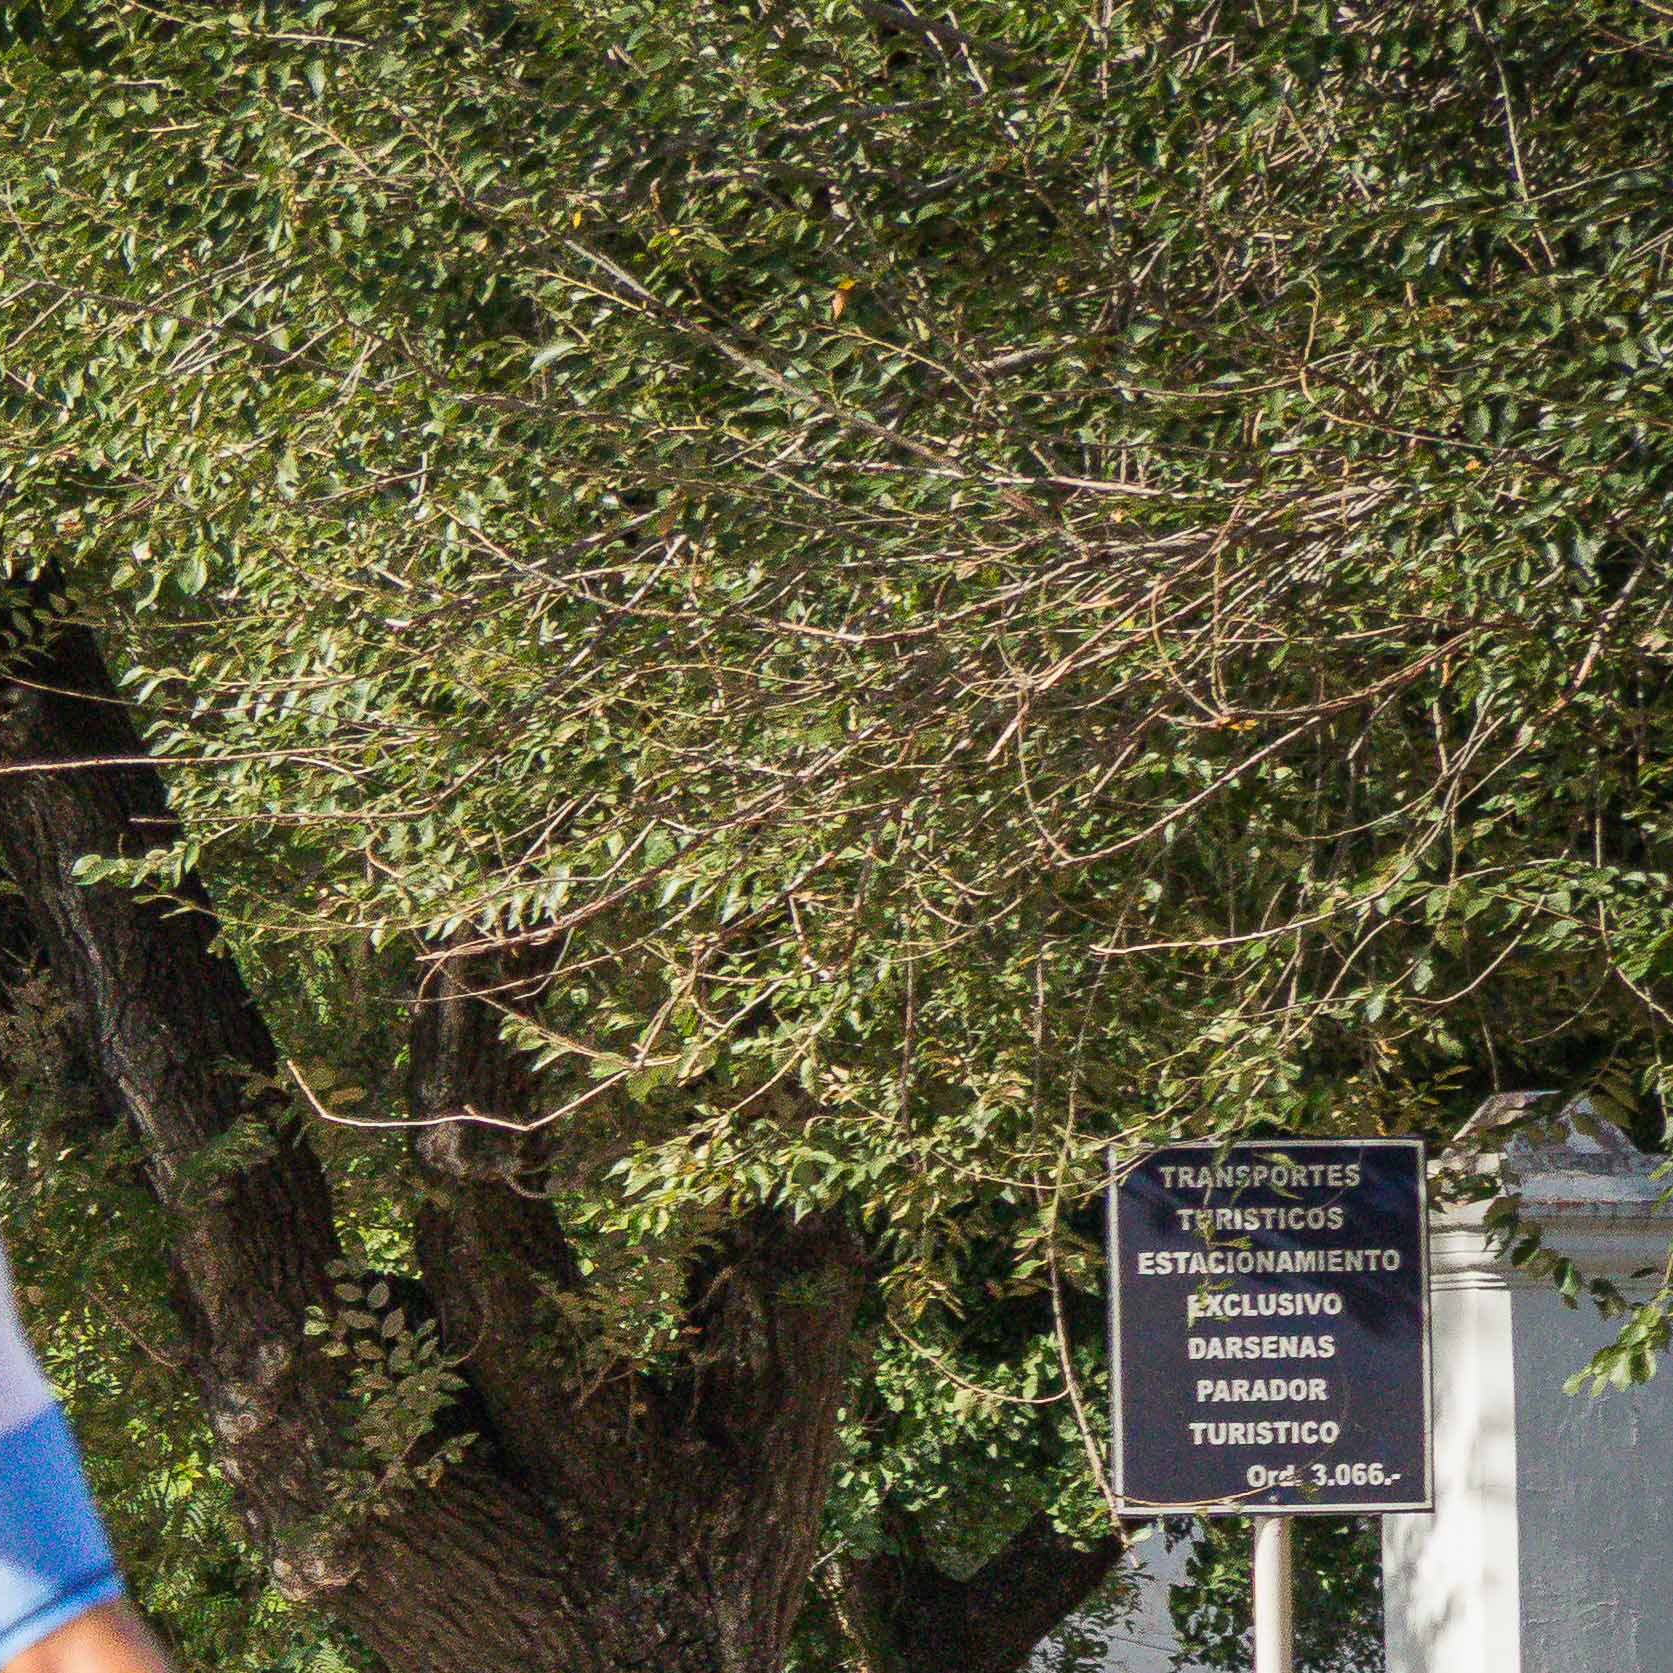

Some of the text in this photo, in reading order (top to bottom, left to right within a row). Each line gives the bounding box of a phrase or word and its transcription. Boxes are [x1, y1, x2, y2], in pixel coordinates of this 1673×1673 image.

[1159, 1164, 1361, 1188] TRANSPORTES
[1137, 1249, 1401, 1275] ESTACIONAMIENTO
[1187, 1293, 1343, 1317] EXCLUSIVO
[1188, 1335, 1336, 1360] DARSENAS
[1195, 1378, 1329, 1402] PARADOR
[1188, 1421, 1340, 1445] TURISTICO
